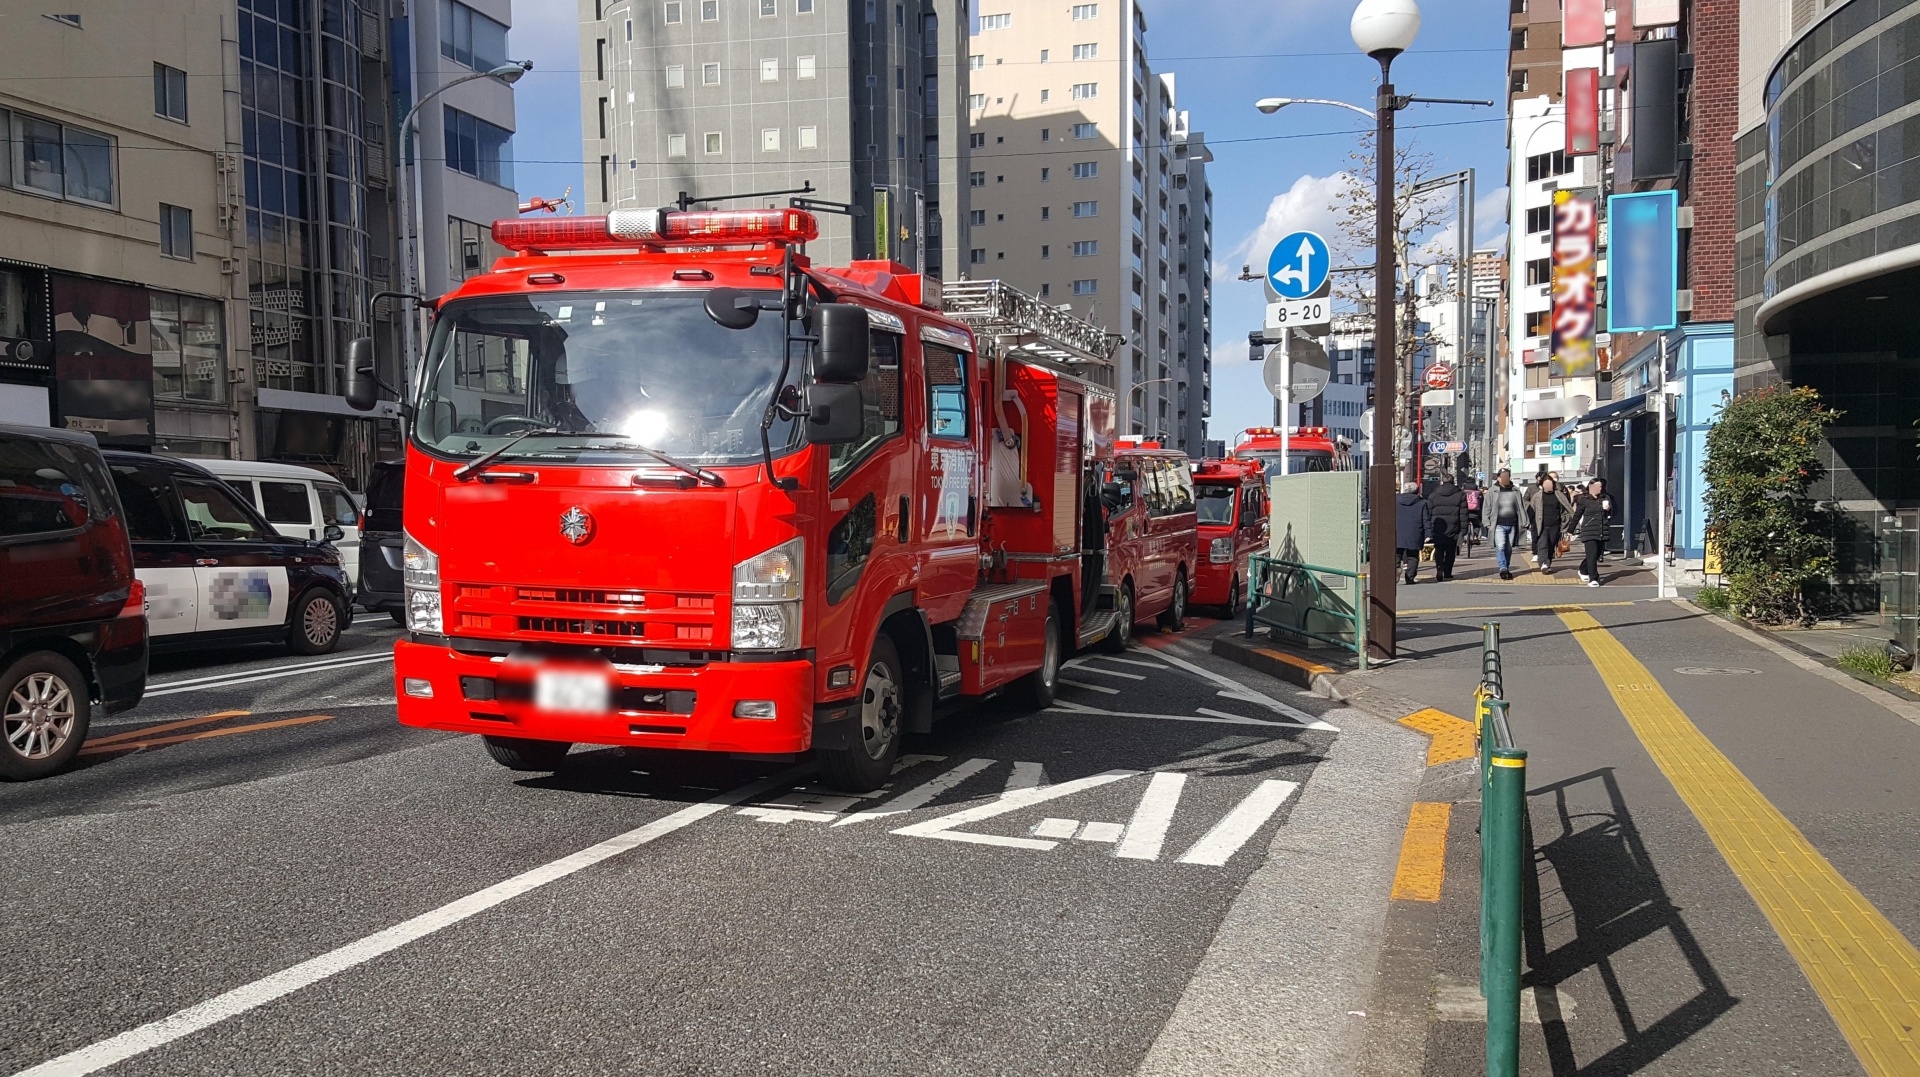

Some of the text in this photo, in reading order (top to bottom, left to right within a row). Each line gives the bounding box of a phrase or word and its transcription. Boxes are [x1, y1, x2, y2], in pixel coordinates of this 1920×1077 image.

[1557, 199, 1592, 340] カラオケ
[1278, 304, 1321, 322] 8-20
[930, 446, 972, 472] 東京消防庁
[949, 476, 960, 488] FIRE
